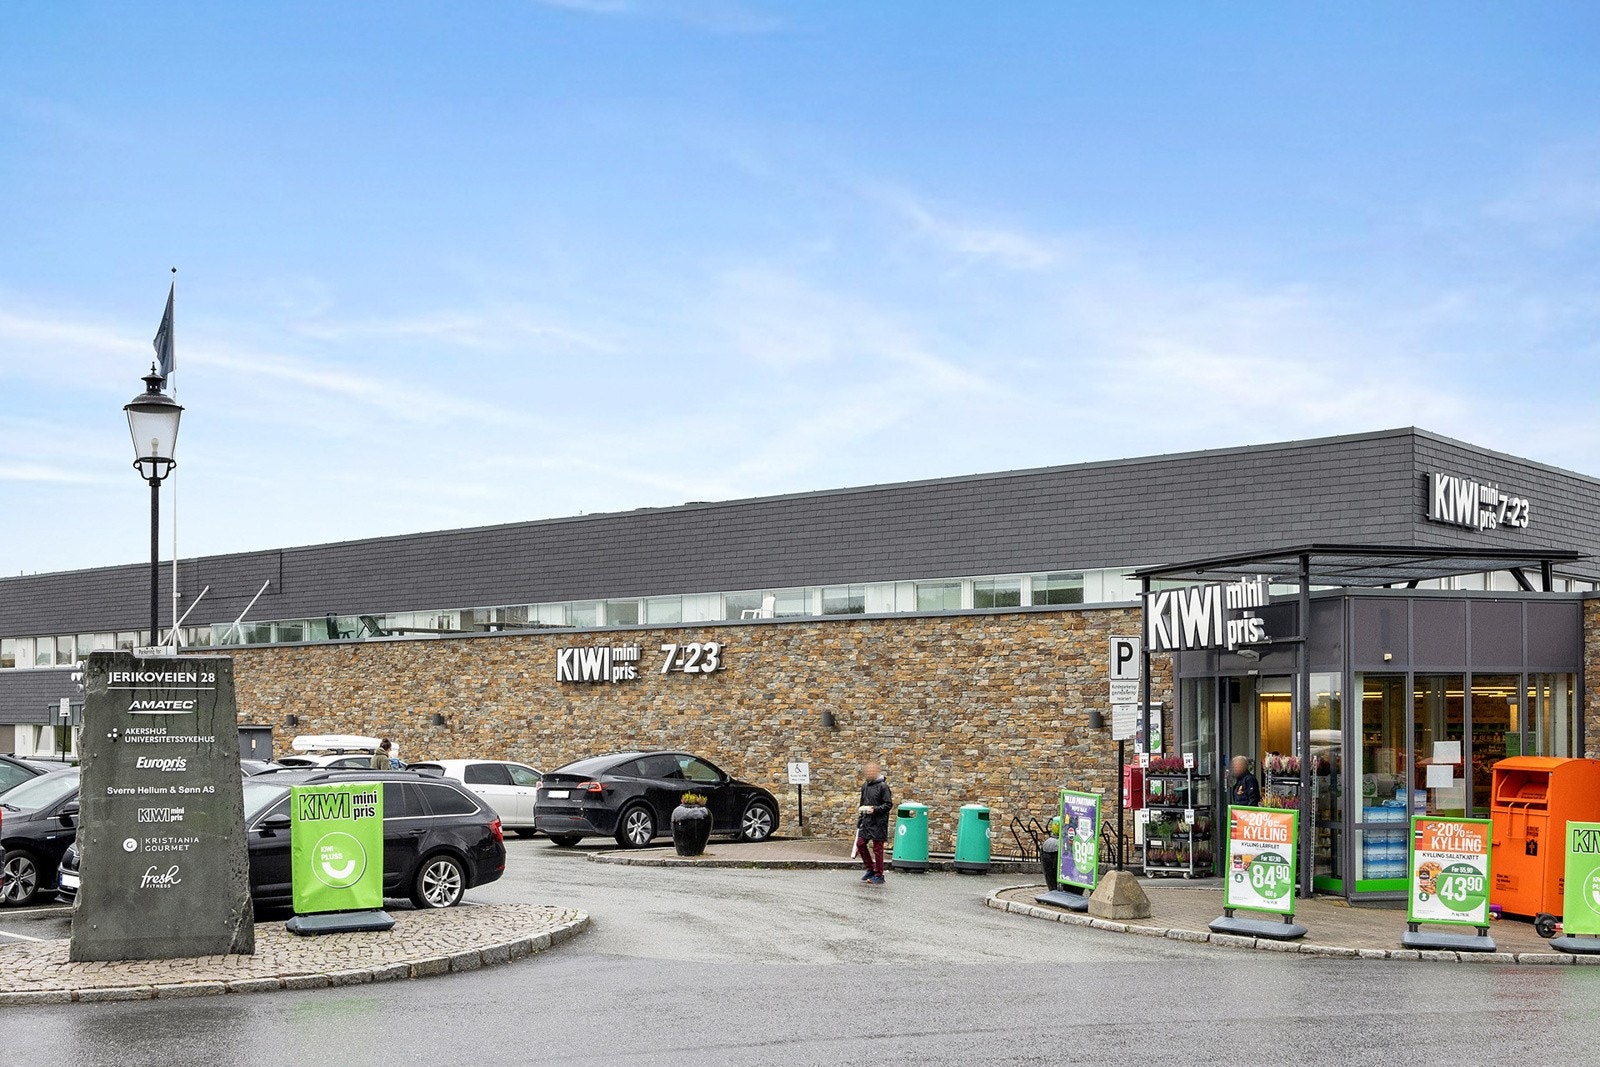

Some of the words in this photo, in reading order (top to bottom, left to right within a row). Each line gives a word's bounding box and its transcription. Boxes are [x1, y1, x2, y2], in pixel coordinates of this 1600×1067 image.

[1435, 473, 1479, 526] KIWI
[1480, 482, 1498, 506] mini
[1499, 494, 1530, 528] 7-23
[1480, 506, 1497, 531] pris
[1226, 574, 1264, 609] mini
[1147, 584, 1223, 650] KIWI
[1226, 611, 1265, 651] pris
[612, 643, 639, 661] mini
[1117, 641, 1134, 675] P
[556, 646, 610, 682] KIWI
[660, 642, 719, 674] 7-23
[107, 672, 197, 684] JERIKOVEIEN
[200, 672, 215, 683] 28
[612, 662, 637, 684] pris
[128, 700, 194, 710] AMATEC
[136, 756, 187, 772] Europris
[107, 786, 136, 795] Sverre
[137, 786, 168, 794] Hellum
[169, 786, 176, 794] &
[178, 786, 200, 794] Sønn
[202, 785, 215, 793] AS
[138, 808, 170, 822] KIWI
[299, 793, 350, 821] KIWI
[352, 791, 377, 805] mini
[353, 805, 375, 821] pris
[170, 814, 183, 822] pris
[1243, 826, 1287, 842] KYLLING
[145, 844, 190, 852] GOURMET
[1431, 836, 1482, 852] KYLLING
[320, 853, 343, 861] PLUSS
[140, 865, 182, 889] fresh
